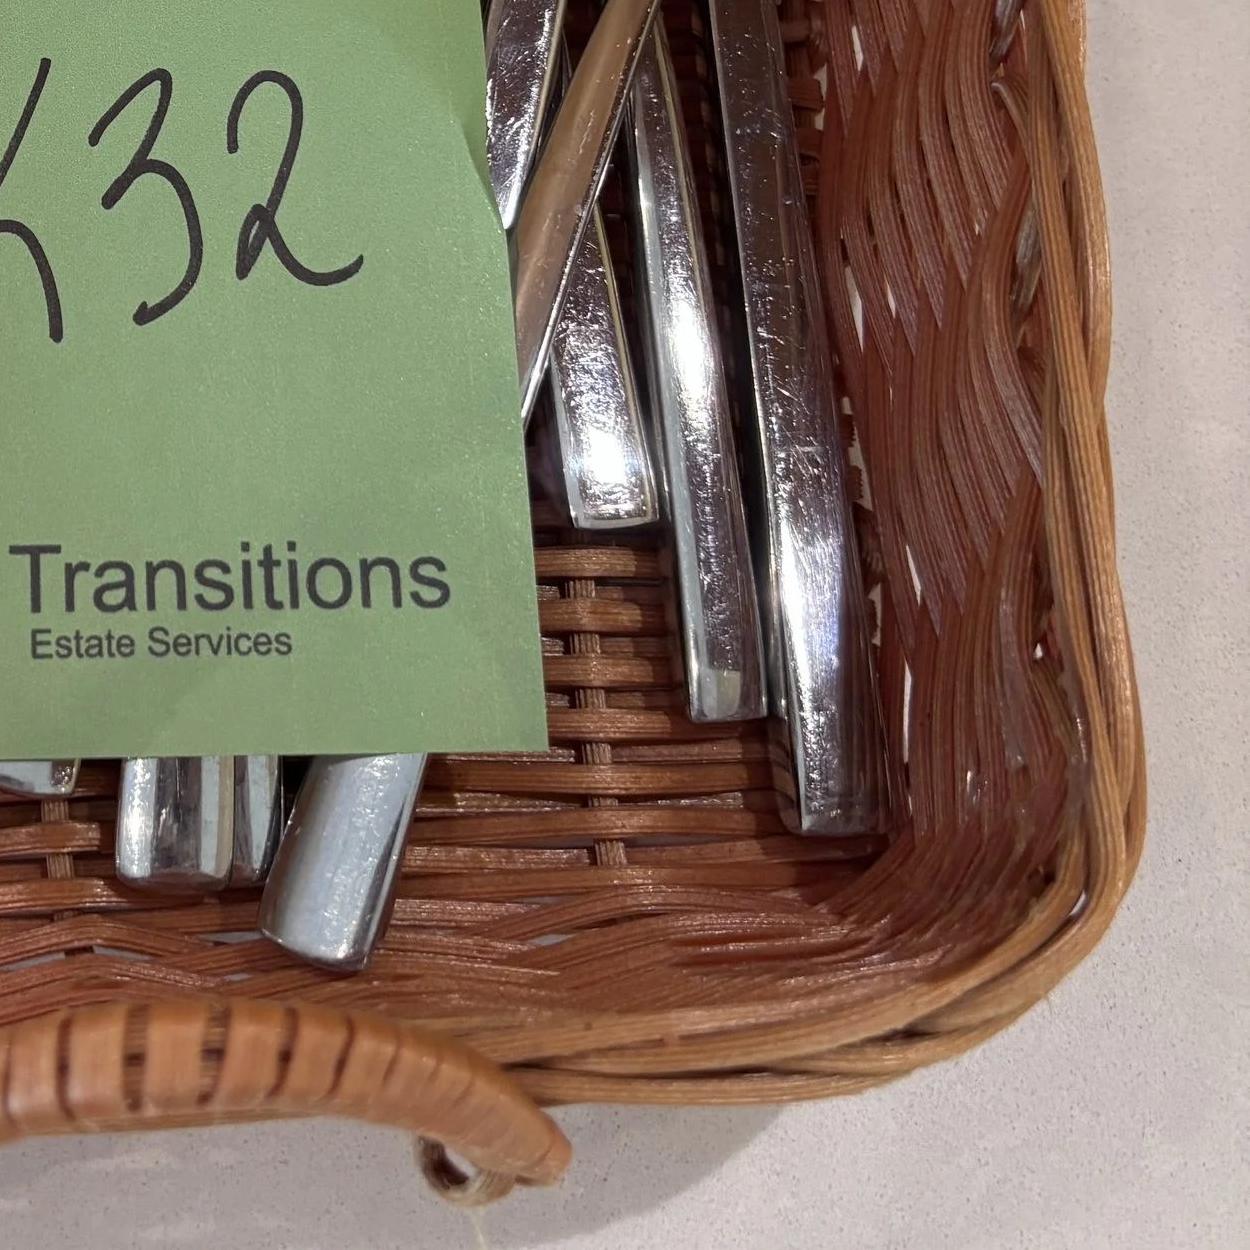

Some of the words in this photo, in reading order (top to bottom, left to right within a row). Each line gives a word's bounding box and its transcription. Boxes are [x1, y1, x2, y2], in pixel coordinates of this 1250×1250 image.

[9, 539, 450, 613] Transitions
[30, 628, 135, 660] Estate
[147, 626, 293, 658] Services
